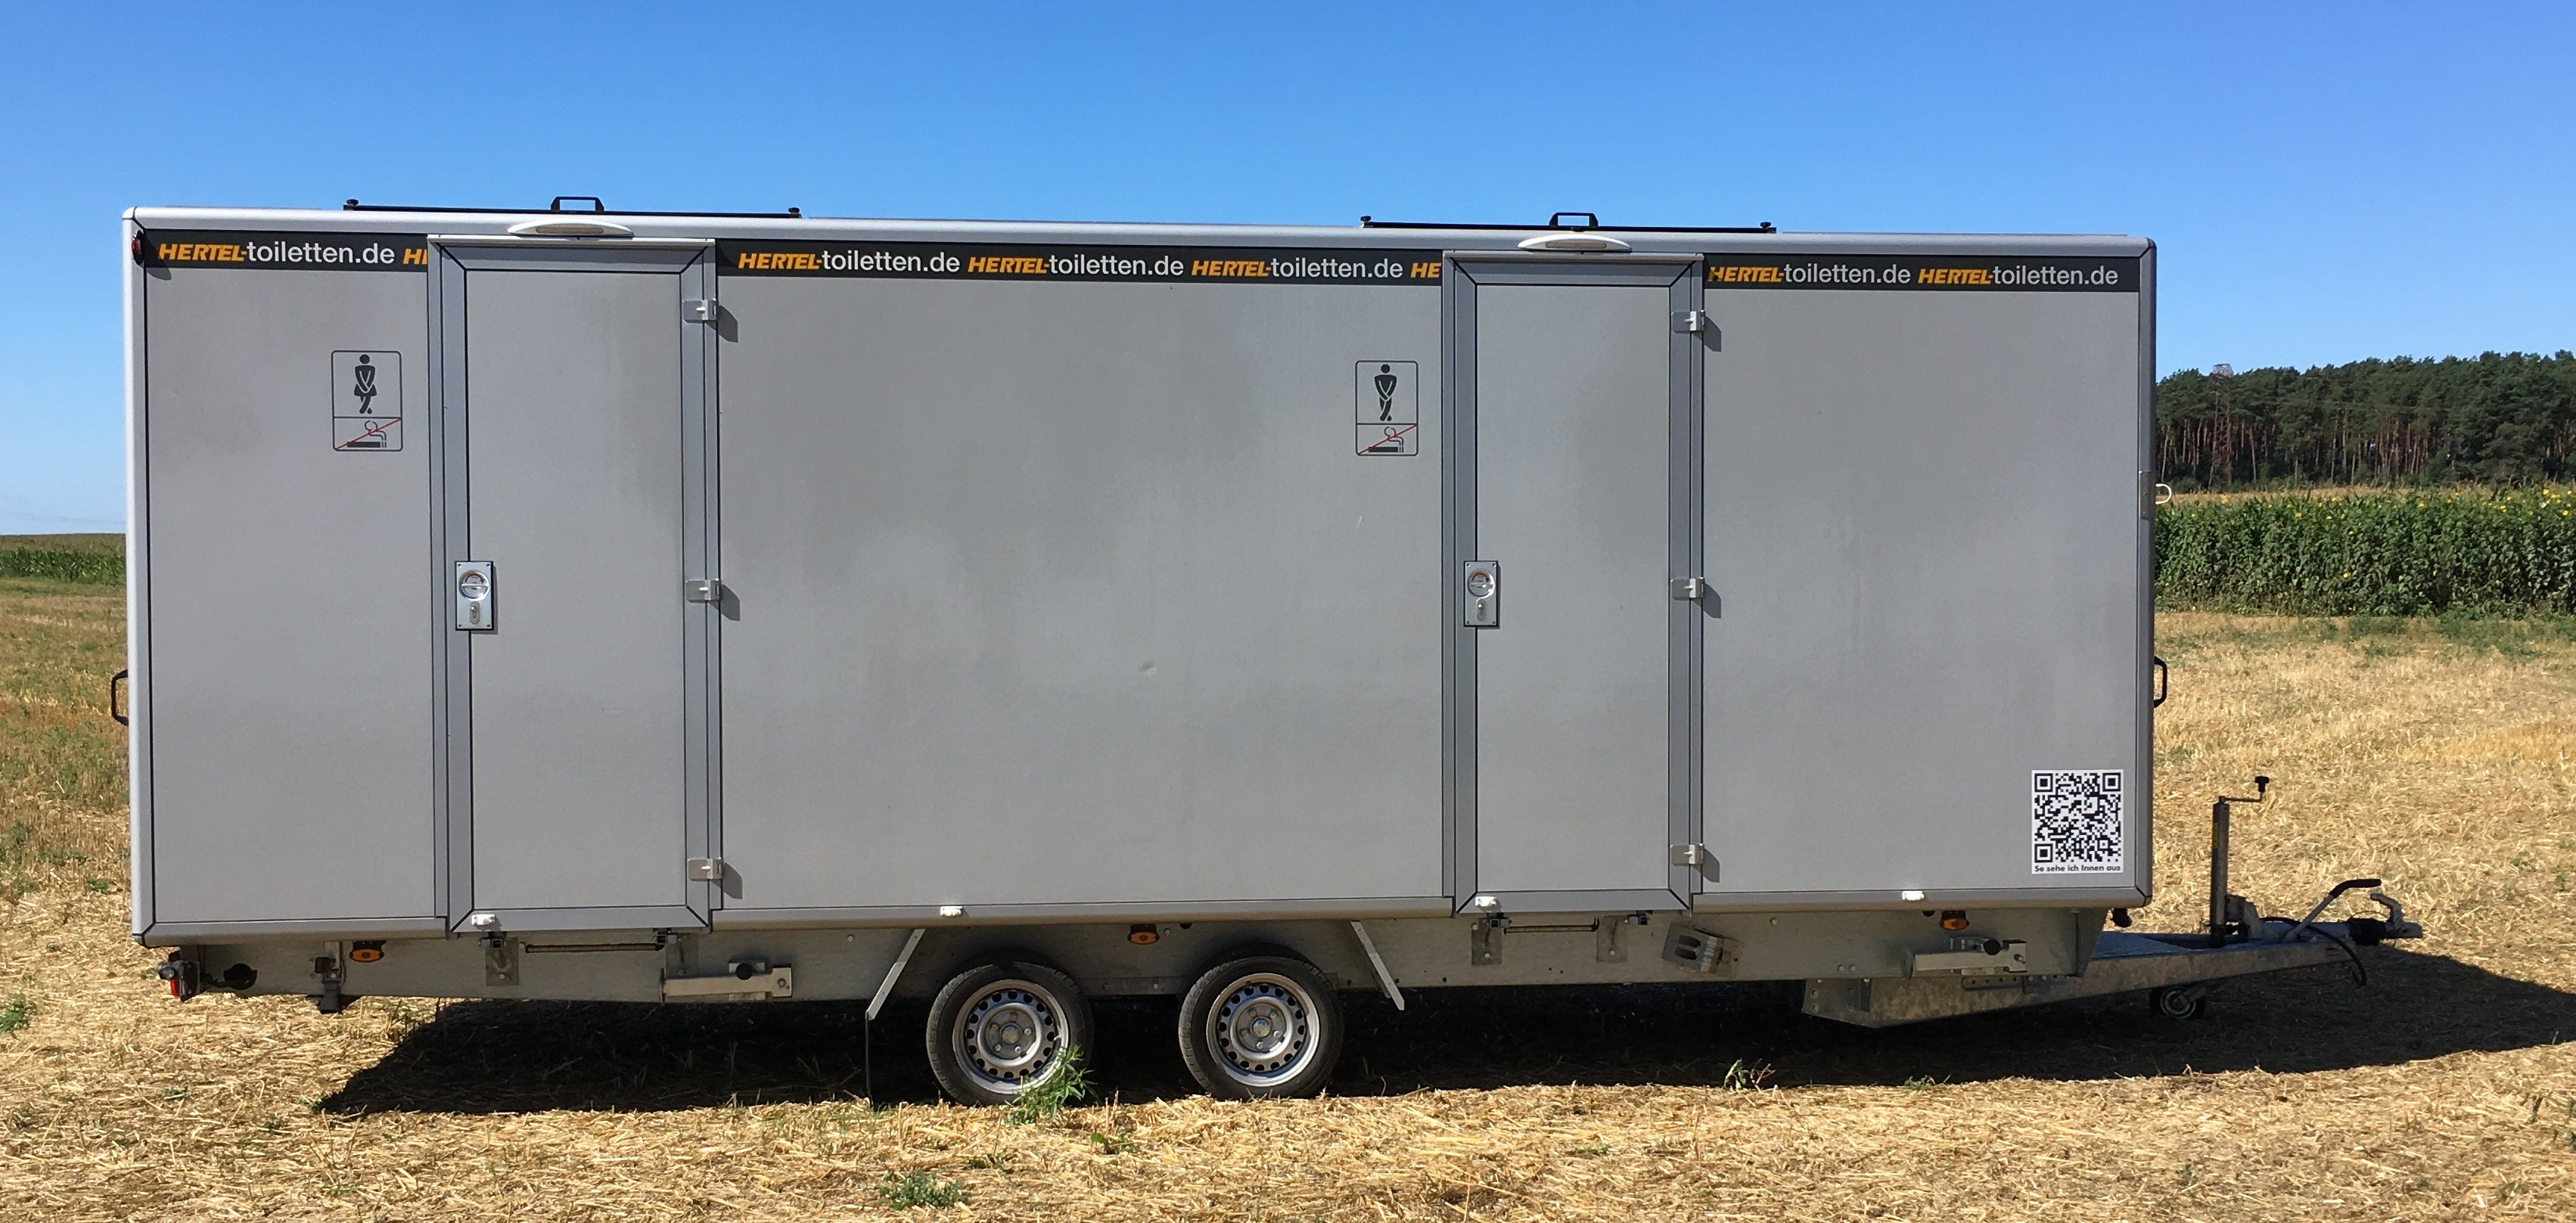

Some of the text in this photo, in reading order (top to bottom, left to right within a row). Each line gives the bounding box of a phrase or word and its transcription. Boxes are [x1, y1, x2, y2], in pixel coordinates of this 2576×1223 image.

[158, 241, 396, 264] HERTEL-toiletten.de
[738, 250, 960, 272] HERTEL-toiletten.de
[968, 254, 1184, 276] HERTEL-toiletten.de
[1192, 258, 1403, 278] HERTEL-toiletten.de
[1707, 263, 2118, 285] HERTEL-toiletten.de HERTEL-toiletten.de
